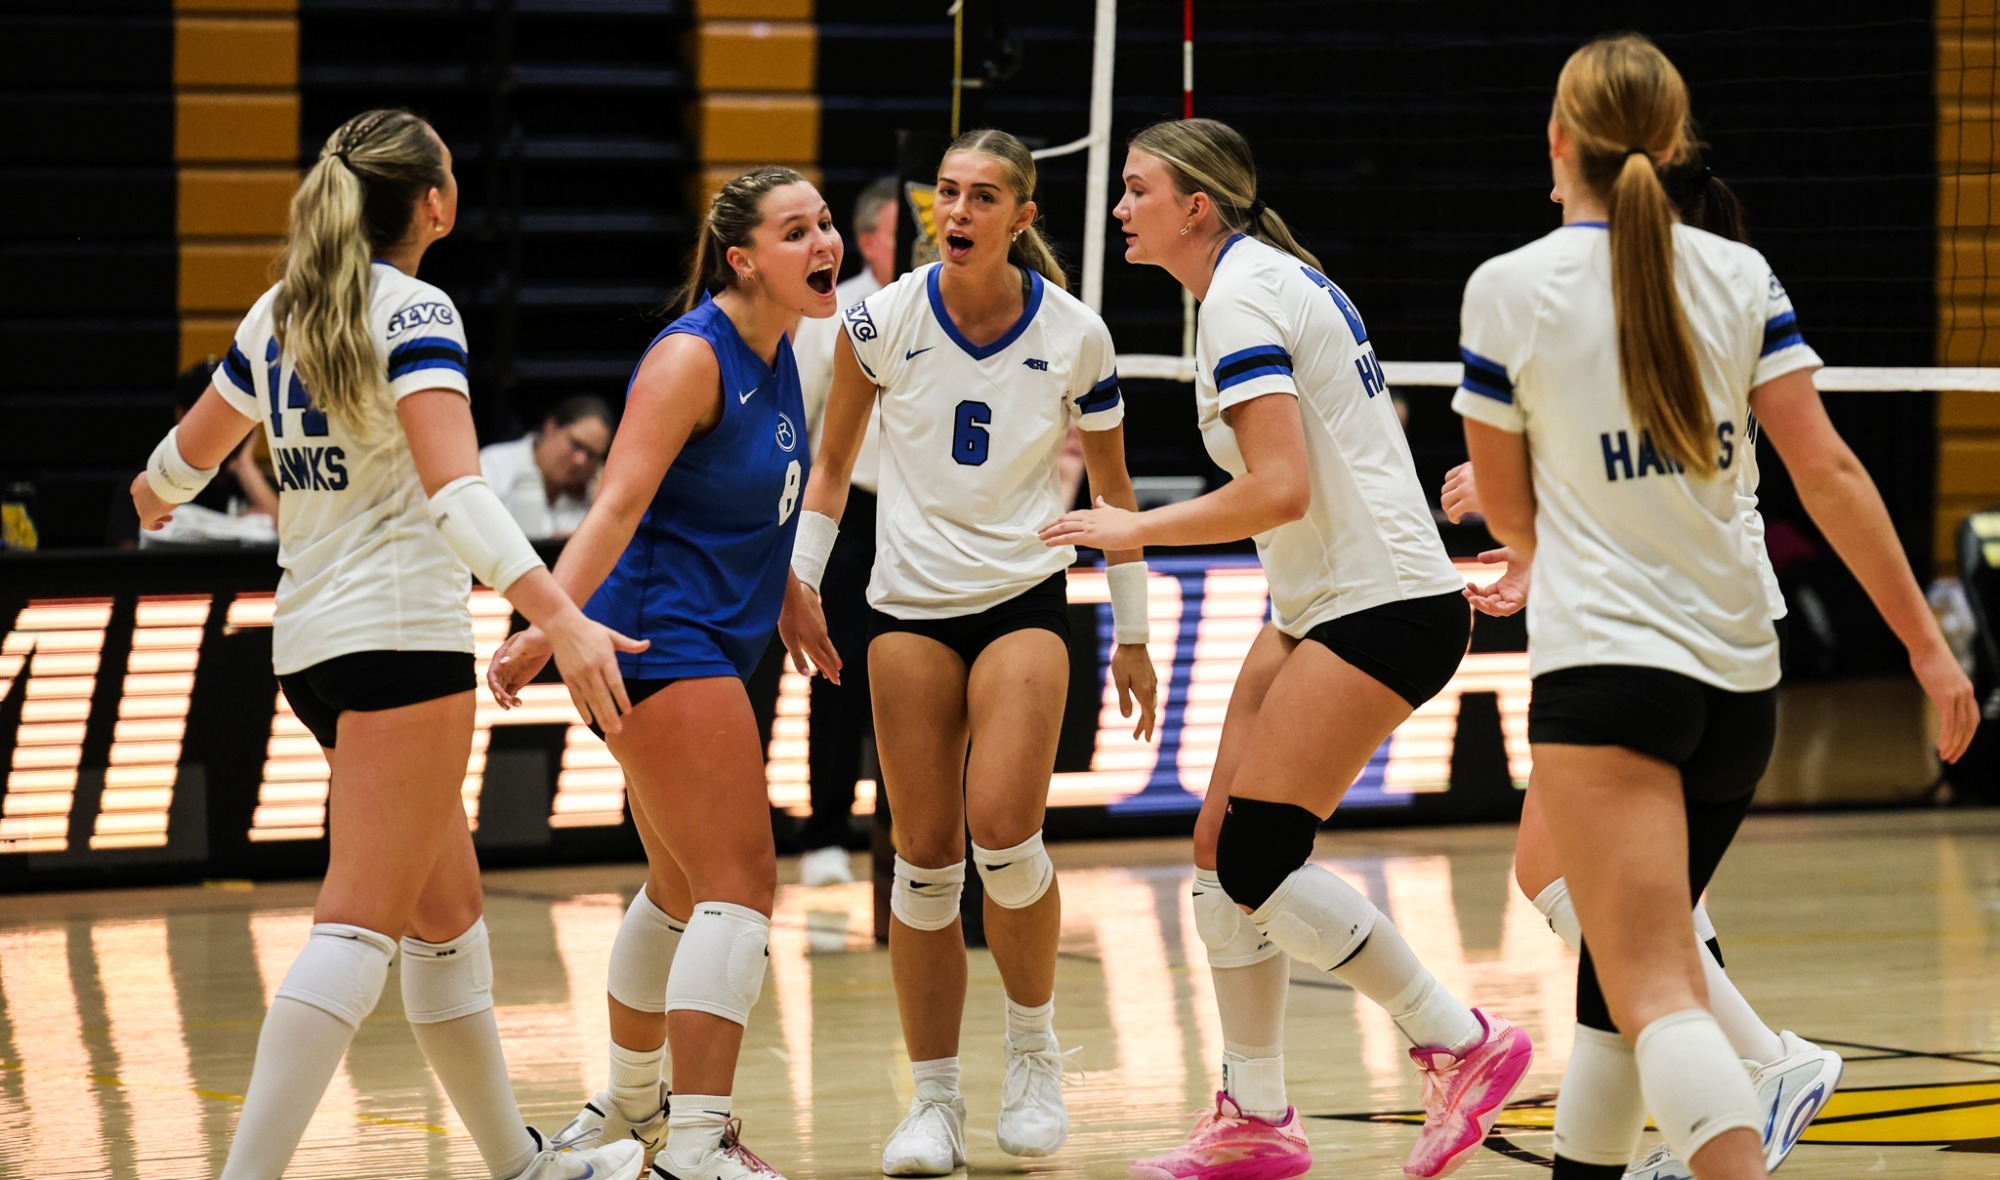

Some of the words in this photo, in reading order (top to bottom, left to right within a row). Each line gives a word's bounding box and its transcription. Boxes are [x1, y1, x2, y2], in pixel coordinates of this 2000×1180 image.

[386, 302, 454, 341] GLVC
[951, 399, 992, 467] 6
[1600, 420, 1734, 482] HAS
[273, 446, 349, 492] AWKS
[778, 459, 802, 526] 8
